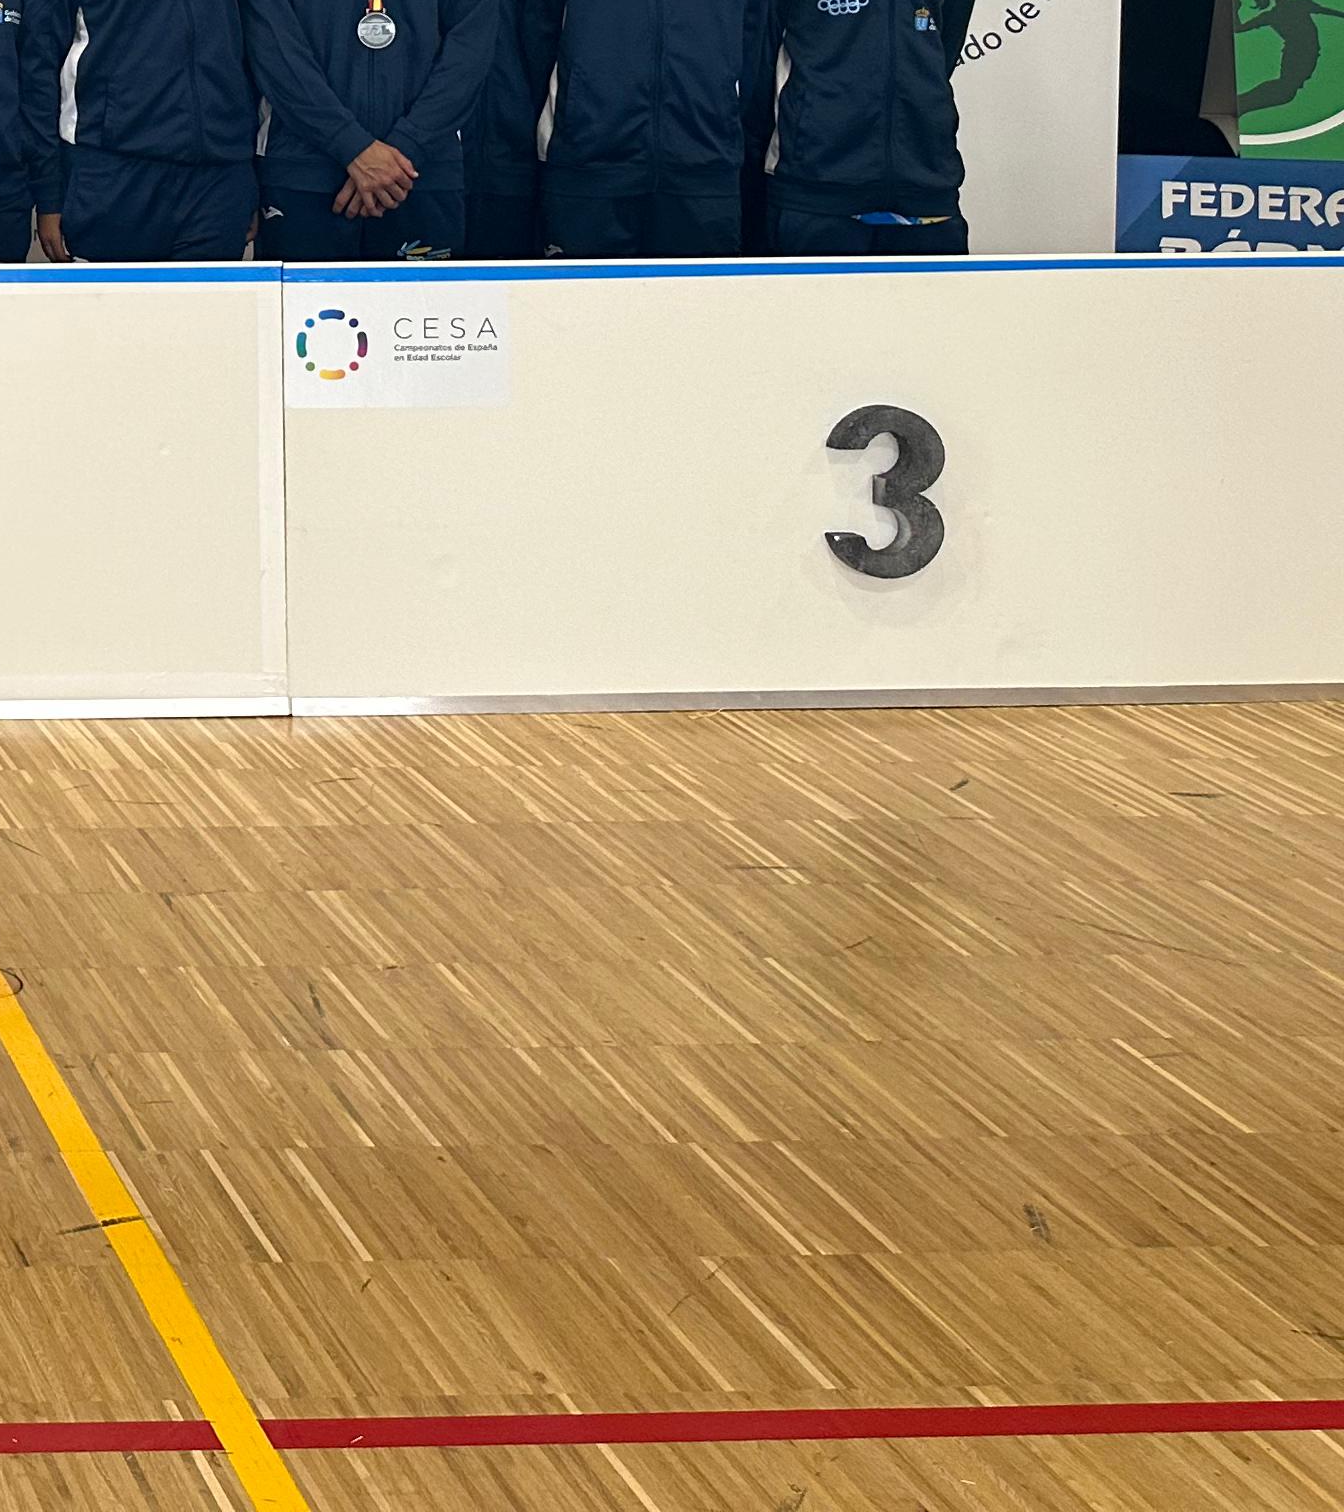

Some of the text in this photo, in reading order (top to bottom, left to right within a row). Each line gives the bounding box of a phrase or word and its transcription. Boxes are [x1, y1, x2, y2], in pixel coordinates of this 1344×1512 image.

[1004, 1, 1040, 34] de
[394, 317, 497, 339] CESA
[394, 344, 451, 352] Campeonatos
[468, 344, 497, 352] España
[825, 404, 945, 579] 3
